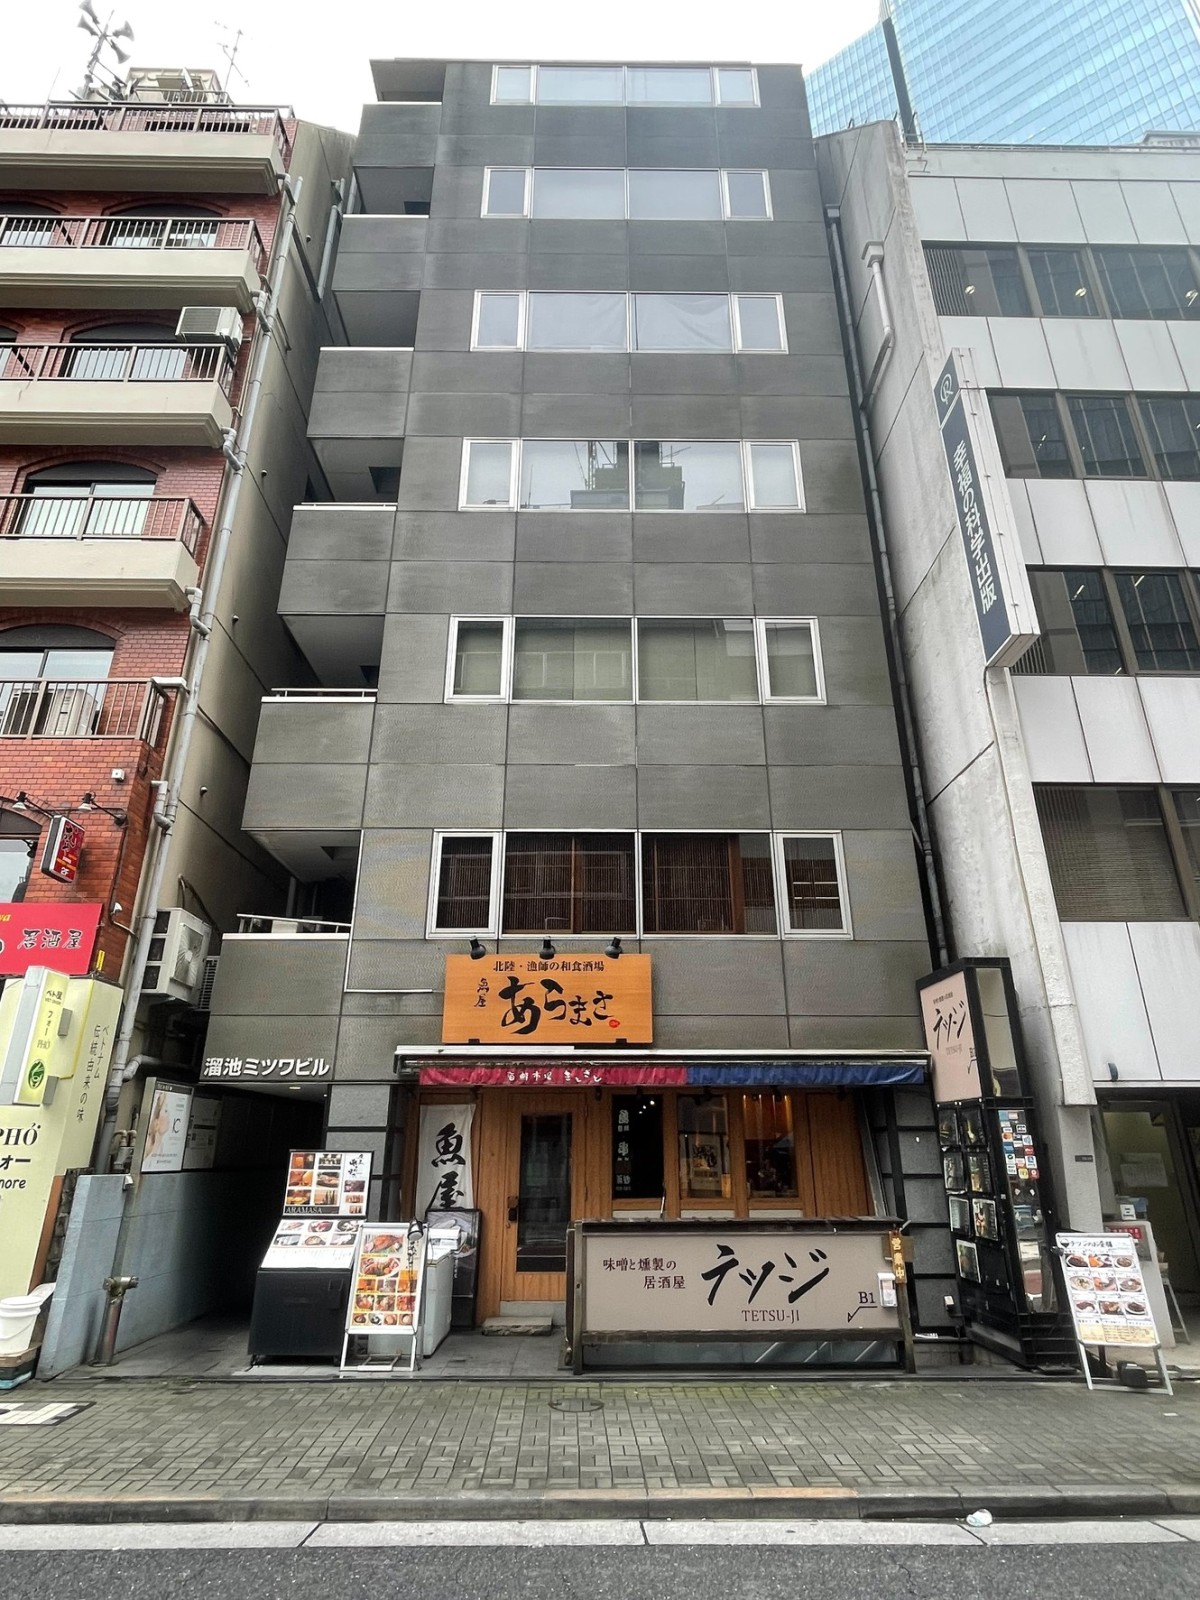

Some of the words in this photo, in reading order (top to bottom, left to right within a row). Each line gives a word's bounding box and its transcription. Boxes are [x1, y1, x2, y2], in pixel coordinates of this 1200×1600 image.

[953, 440, 997, 615] 幸福の科学出版
[17, 928, 83, 949] 居酒屋
[492, 960, 605, 972] 北陸・漁師の和食酒場
[498, 975, 614, 1035] あらまさ
[203, 1057, 330, 1076] 溜池ミツワビル
[427, 1122, 466, 1209] 魚屋
[285, 1206, 323, 1214] ARAMASA
[602, 1257, 677, 1271] 味噌と燻製の
[643, 1275, 686, 1290] 居酒屋
[858, 1291, 876, 1304] B1
[741, 1309, 800, 1323] TETSU-JI
